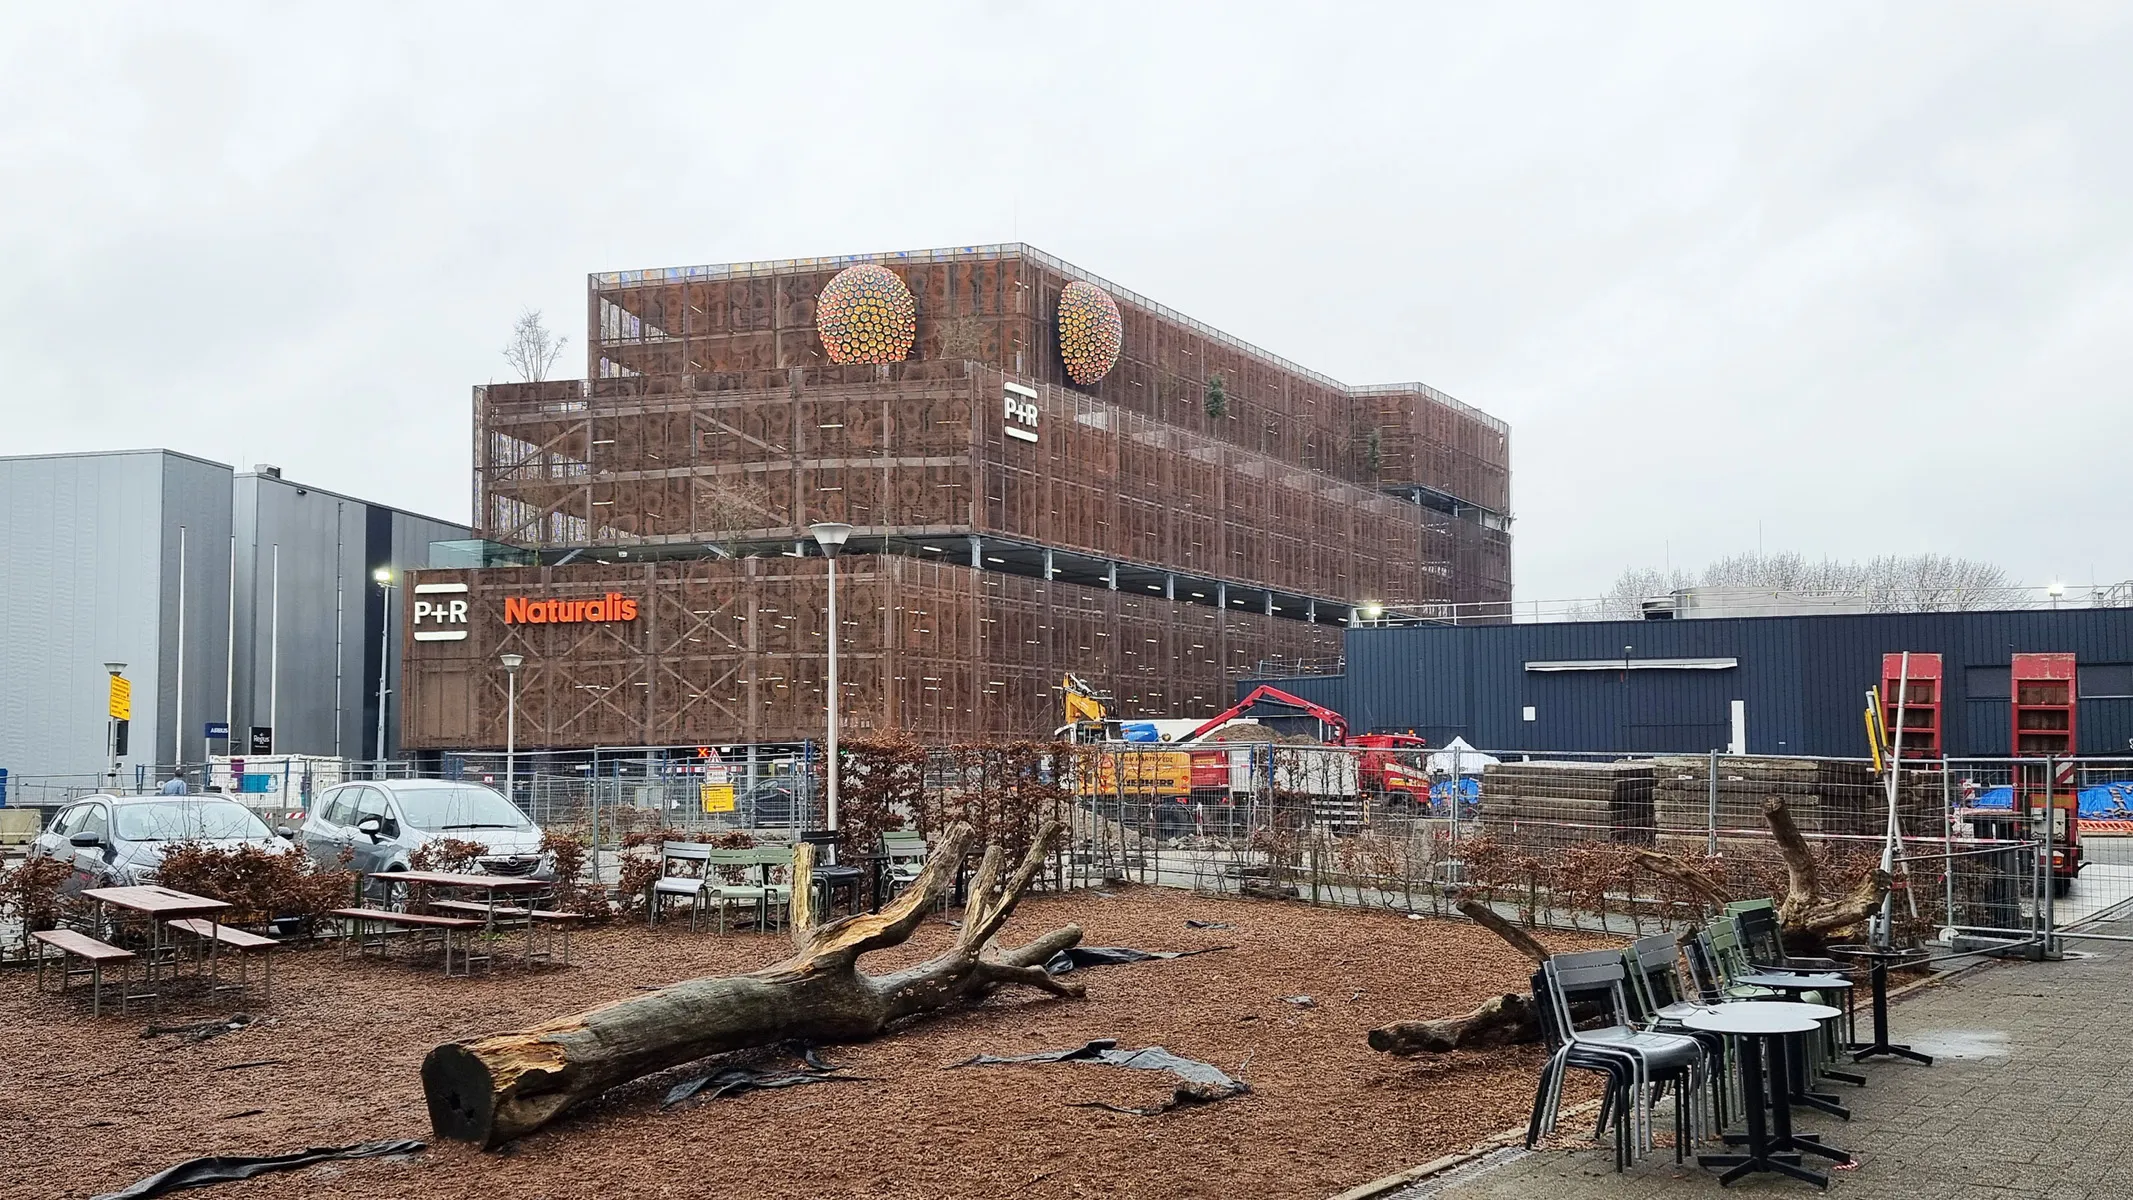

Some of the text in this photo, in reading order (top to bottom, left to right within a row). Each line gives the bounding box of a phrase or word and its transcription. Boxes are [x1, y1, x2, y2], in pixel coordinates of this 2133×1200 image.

[1004, 397, 1038, 427] P+R
[414, 600, 468, 624] P+R
[504, 593, 638, 624] Naturalis
[253, 734, 270, 744] Regus
[1122, 779, 1175, 787] IEBHERR
